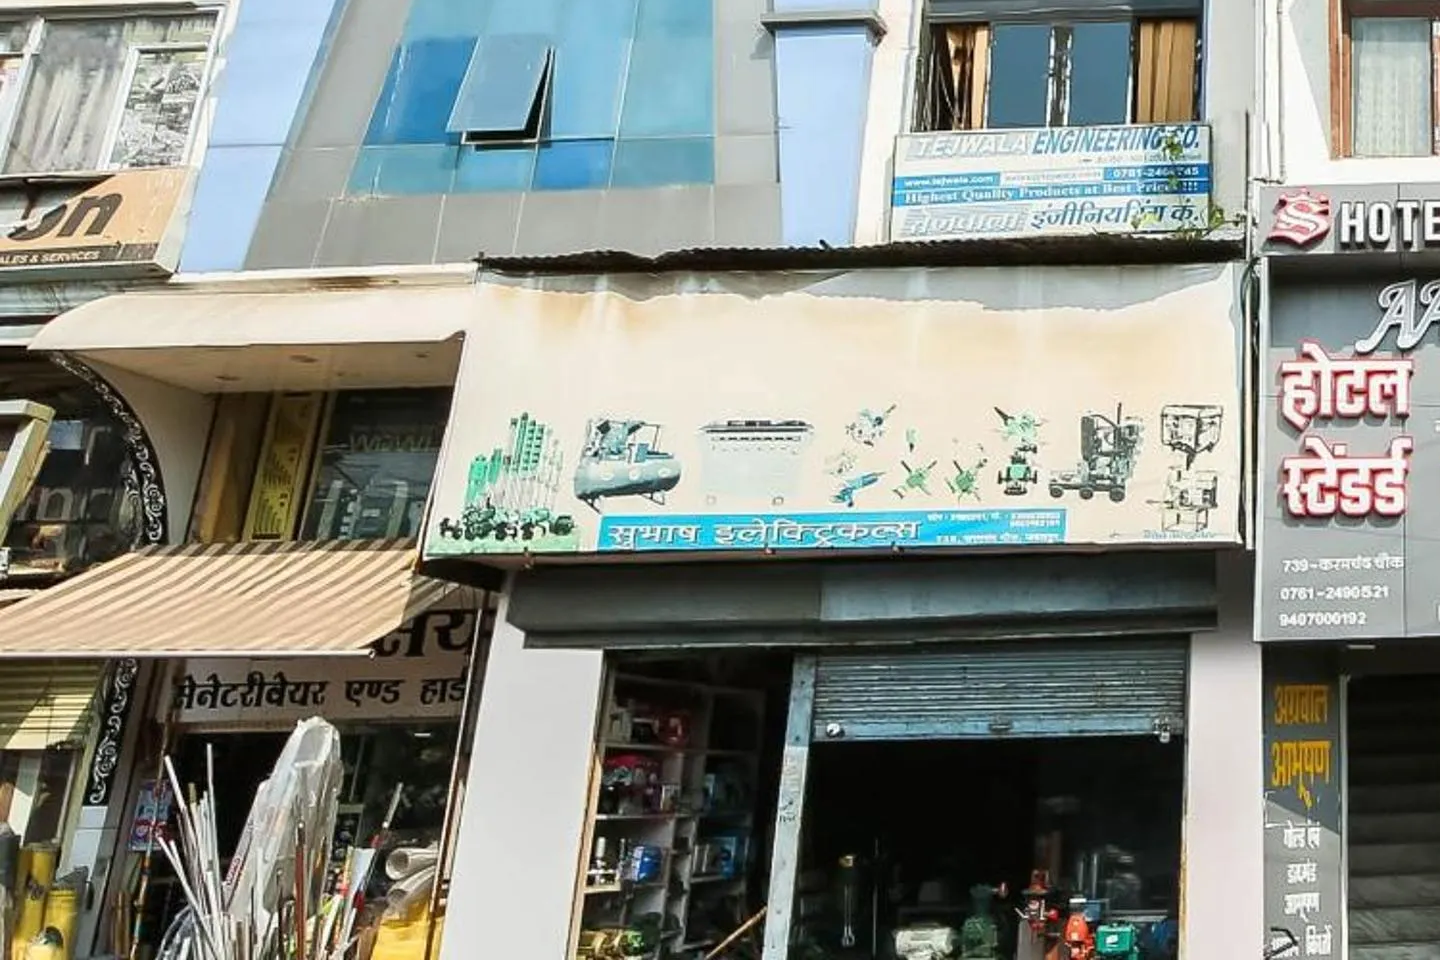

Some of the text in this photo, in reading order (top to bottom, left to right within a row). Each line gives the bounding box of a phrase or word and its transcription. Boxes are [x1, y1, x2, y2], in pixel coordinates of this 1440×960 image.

[907, 135, 1029, 158] TEJWALA
[1031, 125, 1167, 154] ENGINEERING
[904, 174, 994, 188] www.tejwala.com
[905, 189, 958, 205] Highest
[961, 187, 1013, 203] Quality
[1019, 184, 1081, 200] Products
[1084, 185, 1101, 196] at
[1103, 182, 1132, 195] Best
[41, 250, 100, 263] SERVICES
[1281, 341, 1414, 430] होटल
[608, 523, 702, 550] सुभाष
[344, 679, 404, 708] एण्ड
